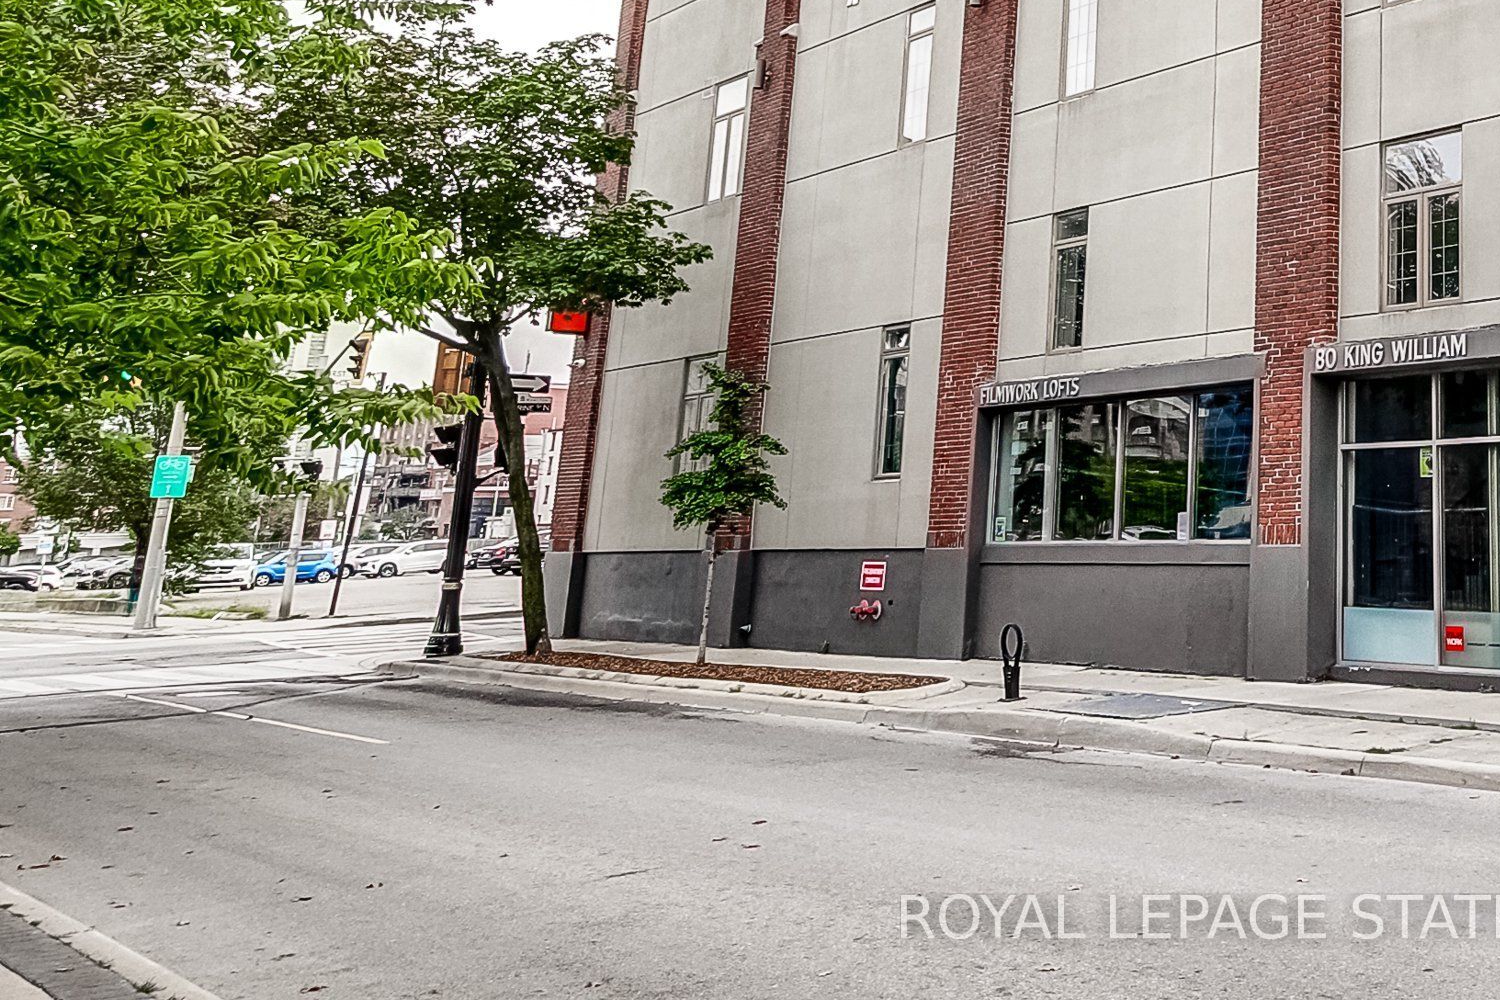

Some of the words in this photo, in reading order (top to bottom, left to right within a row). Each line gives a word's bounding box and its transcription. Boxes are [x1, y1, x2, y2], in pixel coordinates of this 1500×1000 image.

[1315, 347, 1337, 371] 80
[1344, 342, 1384, 368] KING
[1391, 333, 1468, 363] WILLIAM
[980, 381, 1039, 405] FILMWORK
[1043, 377, 1080, 399] LOFTS
